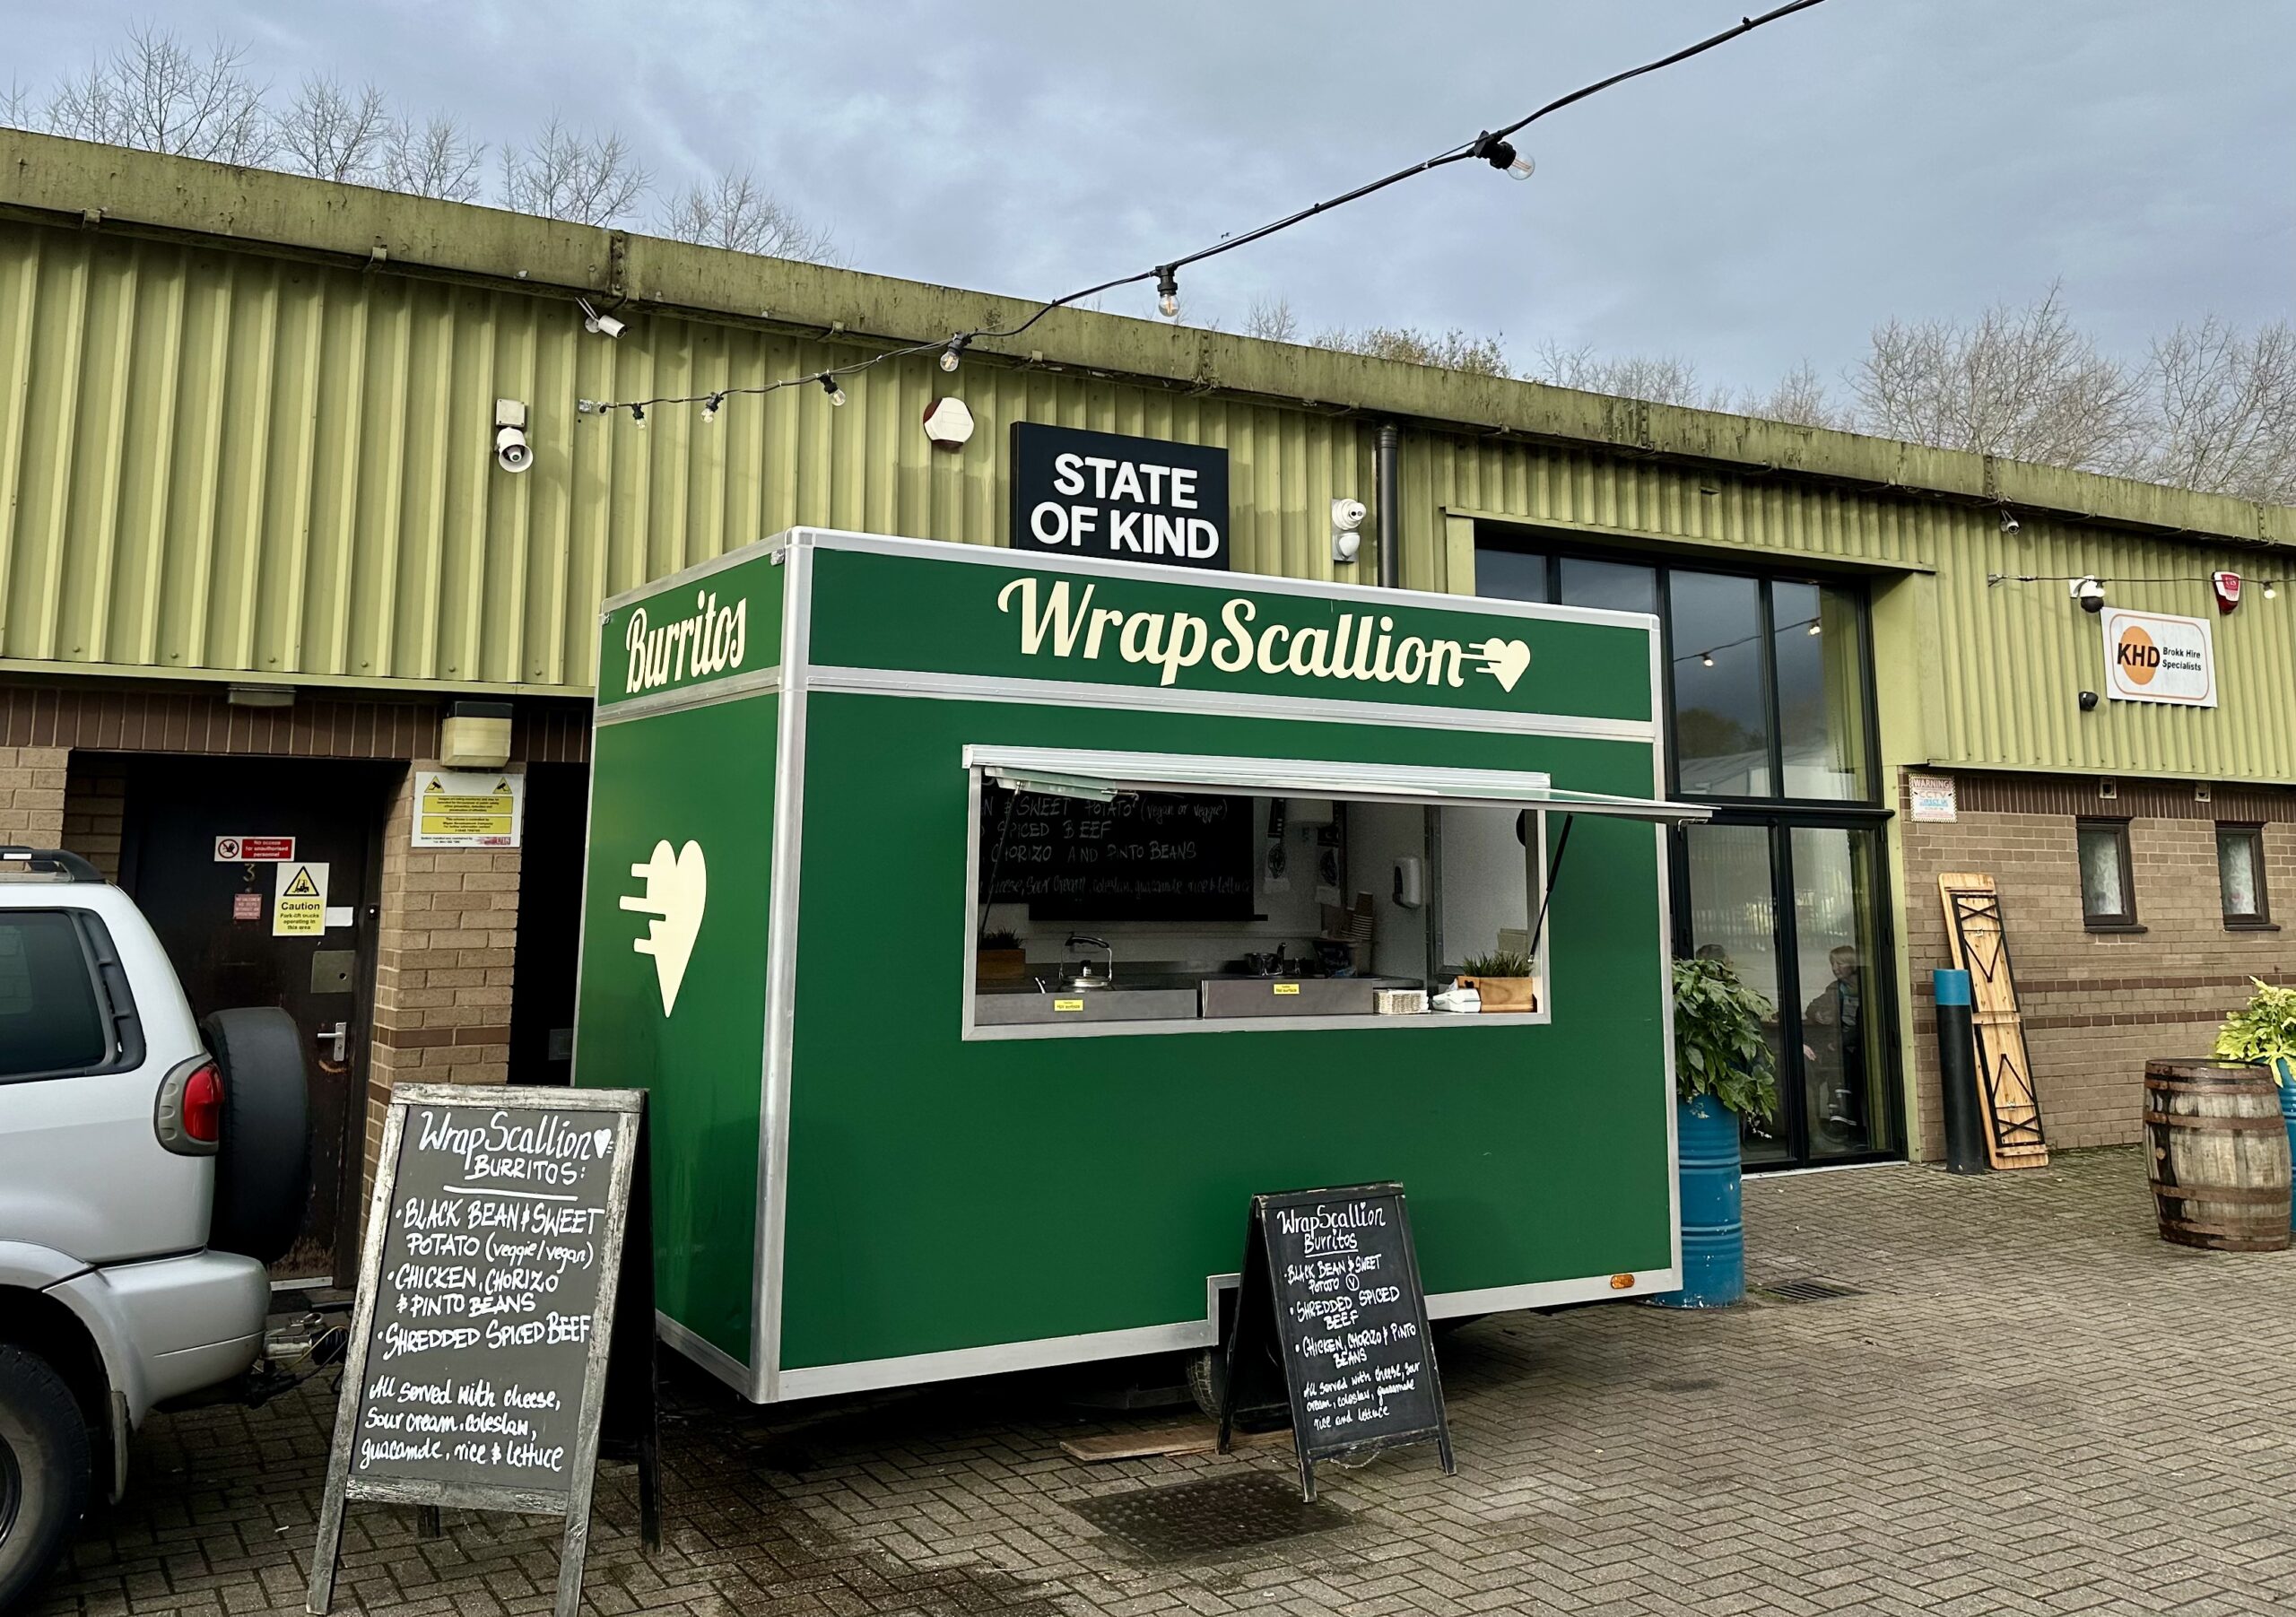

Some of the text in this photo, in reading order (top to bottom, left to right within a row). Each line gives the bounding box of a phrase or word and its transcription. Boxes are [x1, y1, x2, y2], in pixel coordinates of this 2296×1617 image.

[1053, 453, 1198, 510] STATE
[1031, 500, 1220, 559] OF KIND
[626, 589, 746, 693] Burritos
[997, 577, 1465, 688] WrapScallion
[2117, 642, 2161, 668] KHD
[2161, 659, 2202, 672] Specialists
[2162, 647, 2201, 660] Brokk Hire
[1017, 796, 1072, 816] SWEET
[1084, 800, 1133, 817] POTATO
[997, 821, 1049, 839] SPICED
[1063, 820, 1112, 839] BEEF
[1067, 846, 1099, 863] AND
[1149, 840, 1196, 860] BEANS
[282, 902, 320, 910] Caution
[419, 1110, 592, 1170] WrapScallion
[465, 1154, 586, 1185] BURRITOS:
[404, 1197, 463, 1230] BLACK
[467, 1200, 518, 1232] BEAN
[531, 1203, 605, 1237] SWEET
[1276, 1202, 1386, 1238] WrapScallion
[406, 1233, 480, 1256] POTATO
[1304, 1229, 1358, 1254] Burritos
[484, 1267, 559, 1295] CHORIZO
[1287, 1261, 1315, 1285] BLACK
[1318, 1258, 1345, 1279] BEAN
[1355, 1254, 1381, 1274] SWEET
[412, 1293, 465, 1317] PINTO
[469, 1292, 536, 1317] BEANS
[1297, 1286, 1400, 1322] SHREDDED SPICED
[1323, 1310, 1359, 1330] BEEF
[382, 1311, 591, 1361] SHREDDED SPICED BEEF
[1347, 1329, 1382, 1349] CHORIZO
[1333, 1347, 1368, 1369] BEANS
[370, 1375, 561, 1411] All served with cheese,
[1303, 1381, 1318, 1400] All
[1318, 1377, 1348, 1395] served
[1351, 1370, 1371, 1386] with
[1314, 1406, 1390, 1430] rice and lettuce
[455, 1441, 486, 1465] rice
[507, 1440, 564, 1472] lettuce
